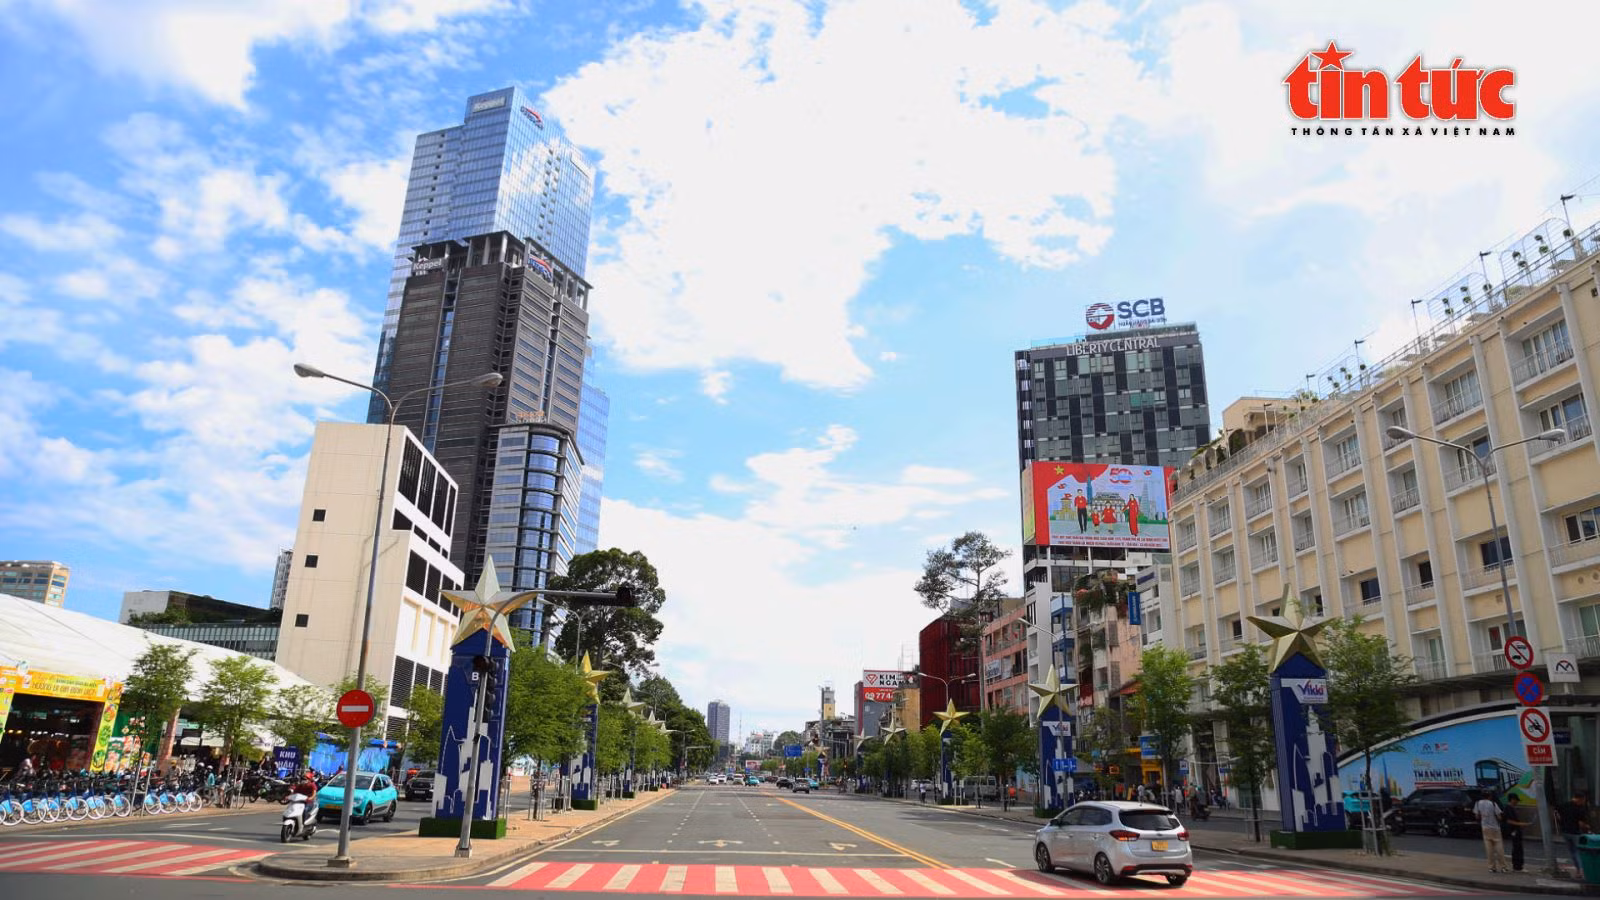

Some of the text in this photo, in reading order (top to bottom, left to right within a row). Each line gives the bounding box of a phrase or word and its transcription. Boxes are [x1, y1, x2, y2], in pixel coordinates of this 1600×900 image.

[1117, 298, 1165, 319] SCB
[1066, 337, 1161, 356] LIBERTY CENTRAL
